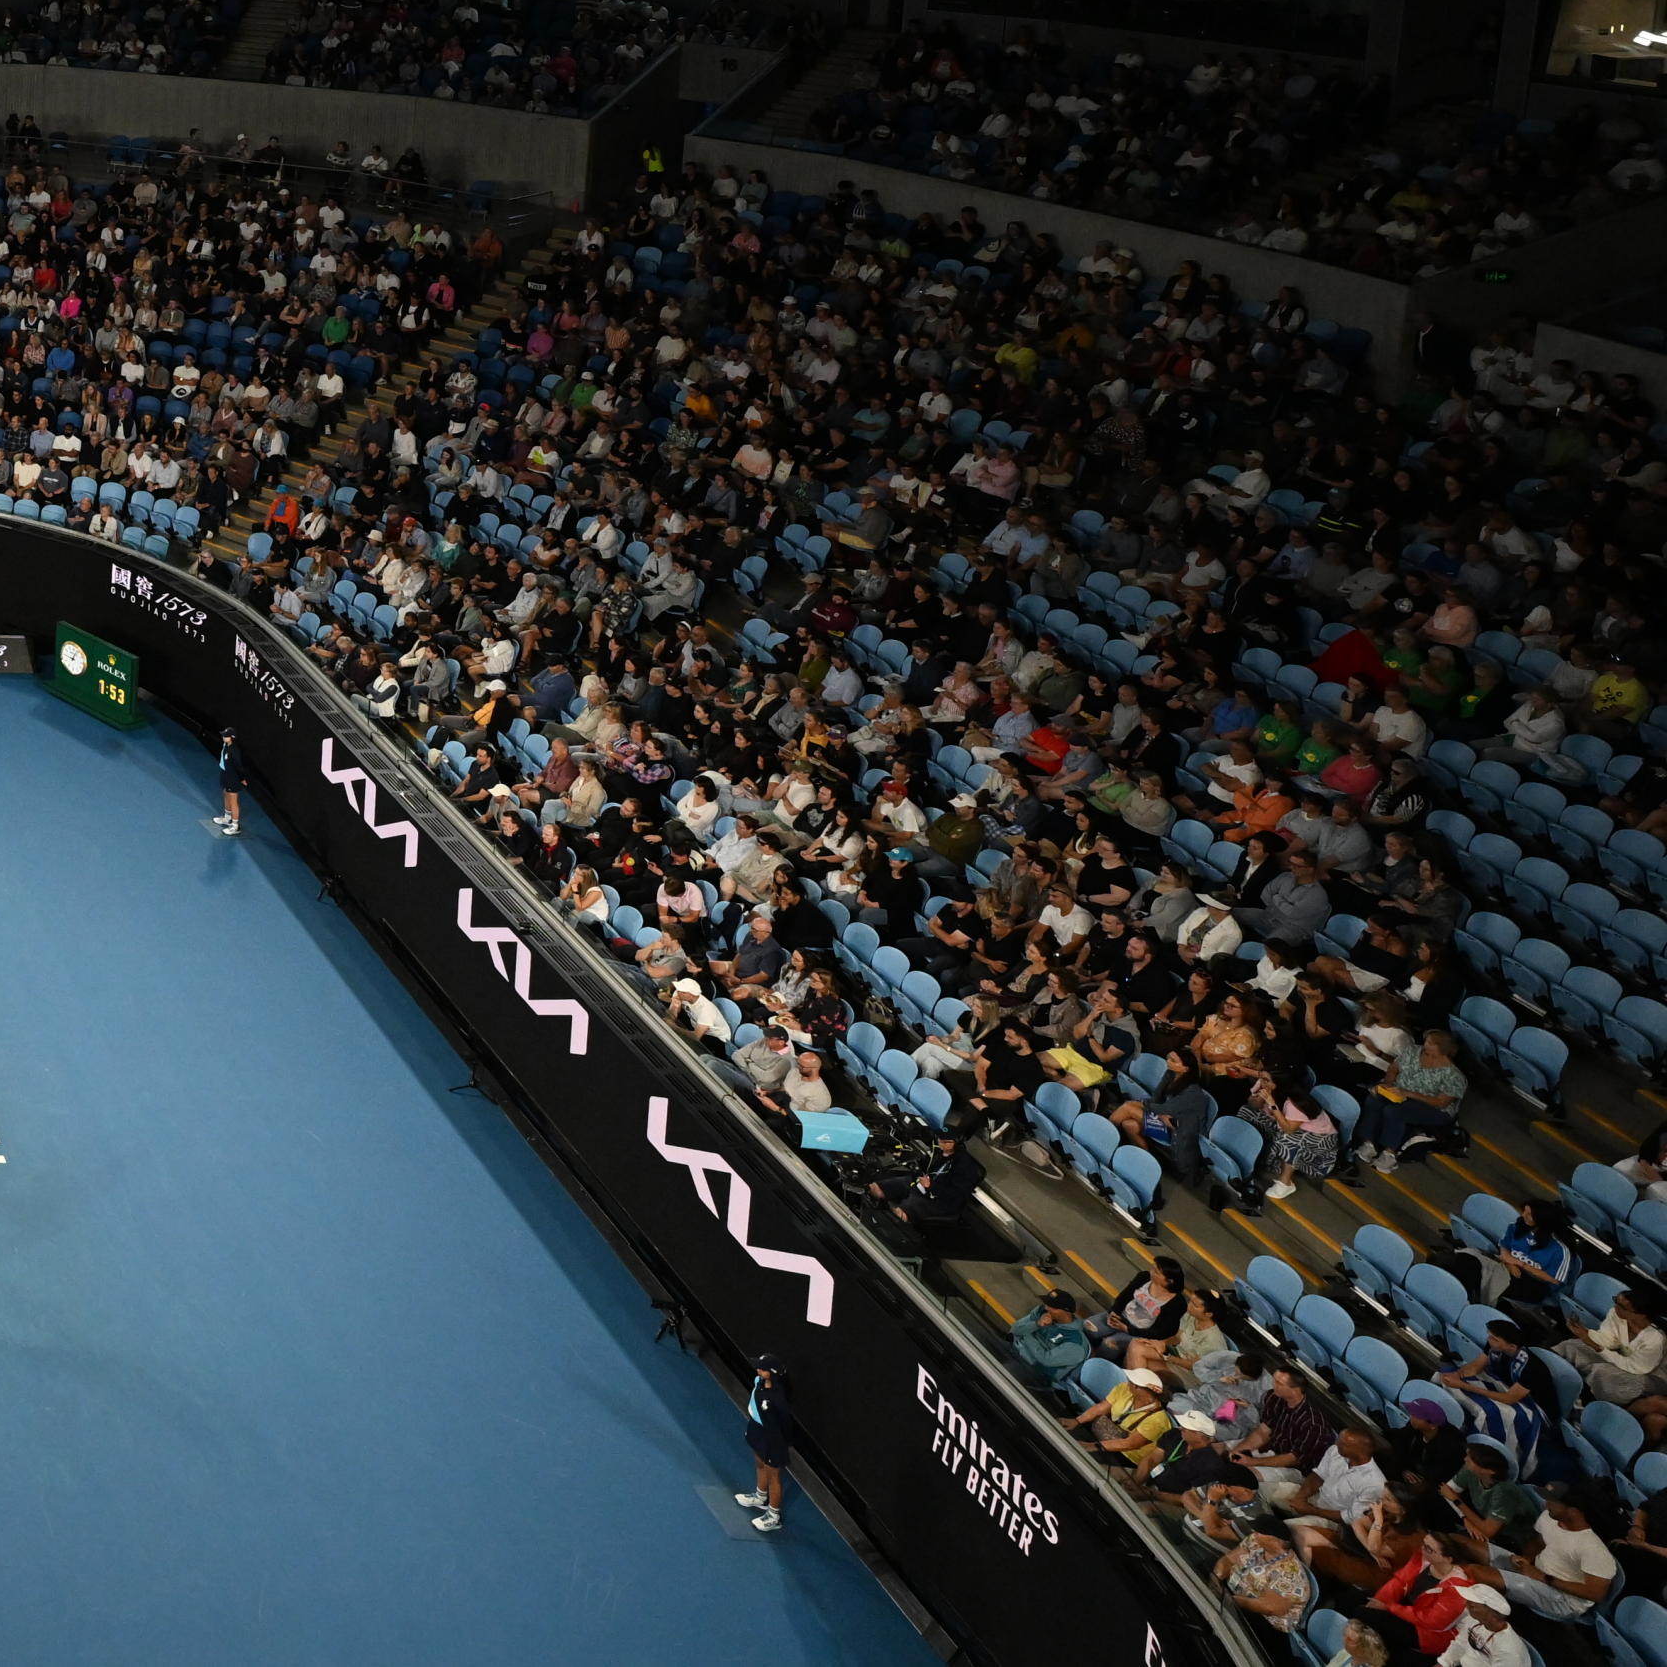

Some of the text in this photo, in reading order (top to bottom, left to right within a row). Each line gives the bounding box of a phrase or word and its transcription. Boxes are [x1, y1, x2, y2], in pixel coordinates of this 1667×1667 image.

[720, 58, 738, 72] 16
[97, 660, 127, 681] ROLEX
[98, 679, 125, 705] 1:53
[177, 620, 205, 643] 1573
[321, 738, 418, 867] KIA
[457, 888, 589, 1056] KIA
[647, 1096, 835, 1327] KIA
[917, 1362, 1059, 1545] Emirates
[932, 1427, 1034, 1557] FLY BETTER
